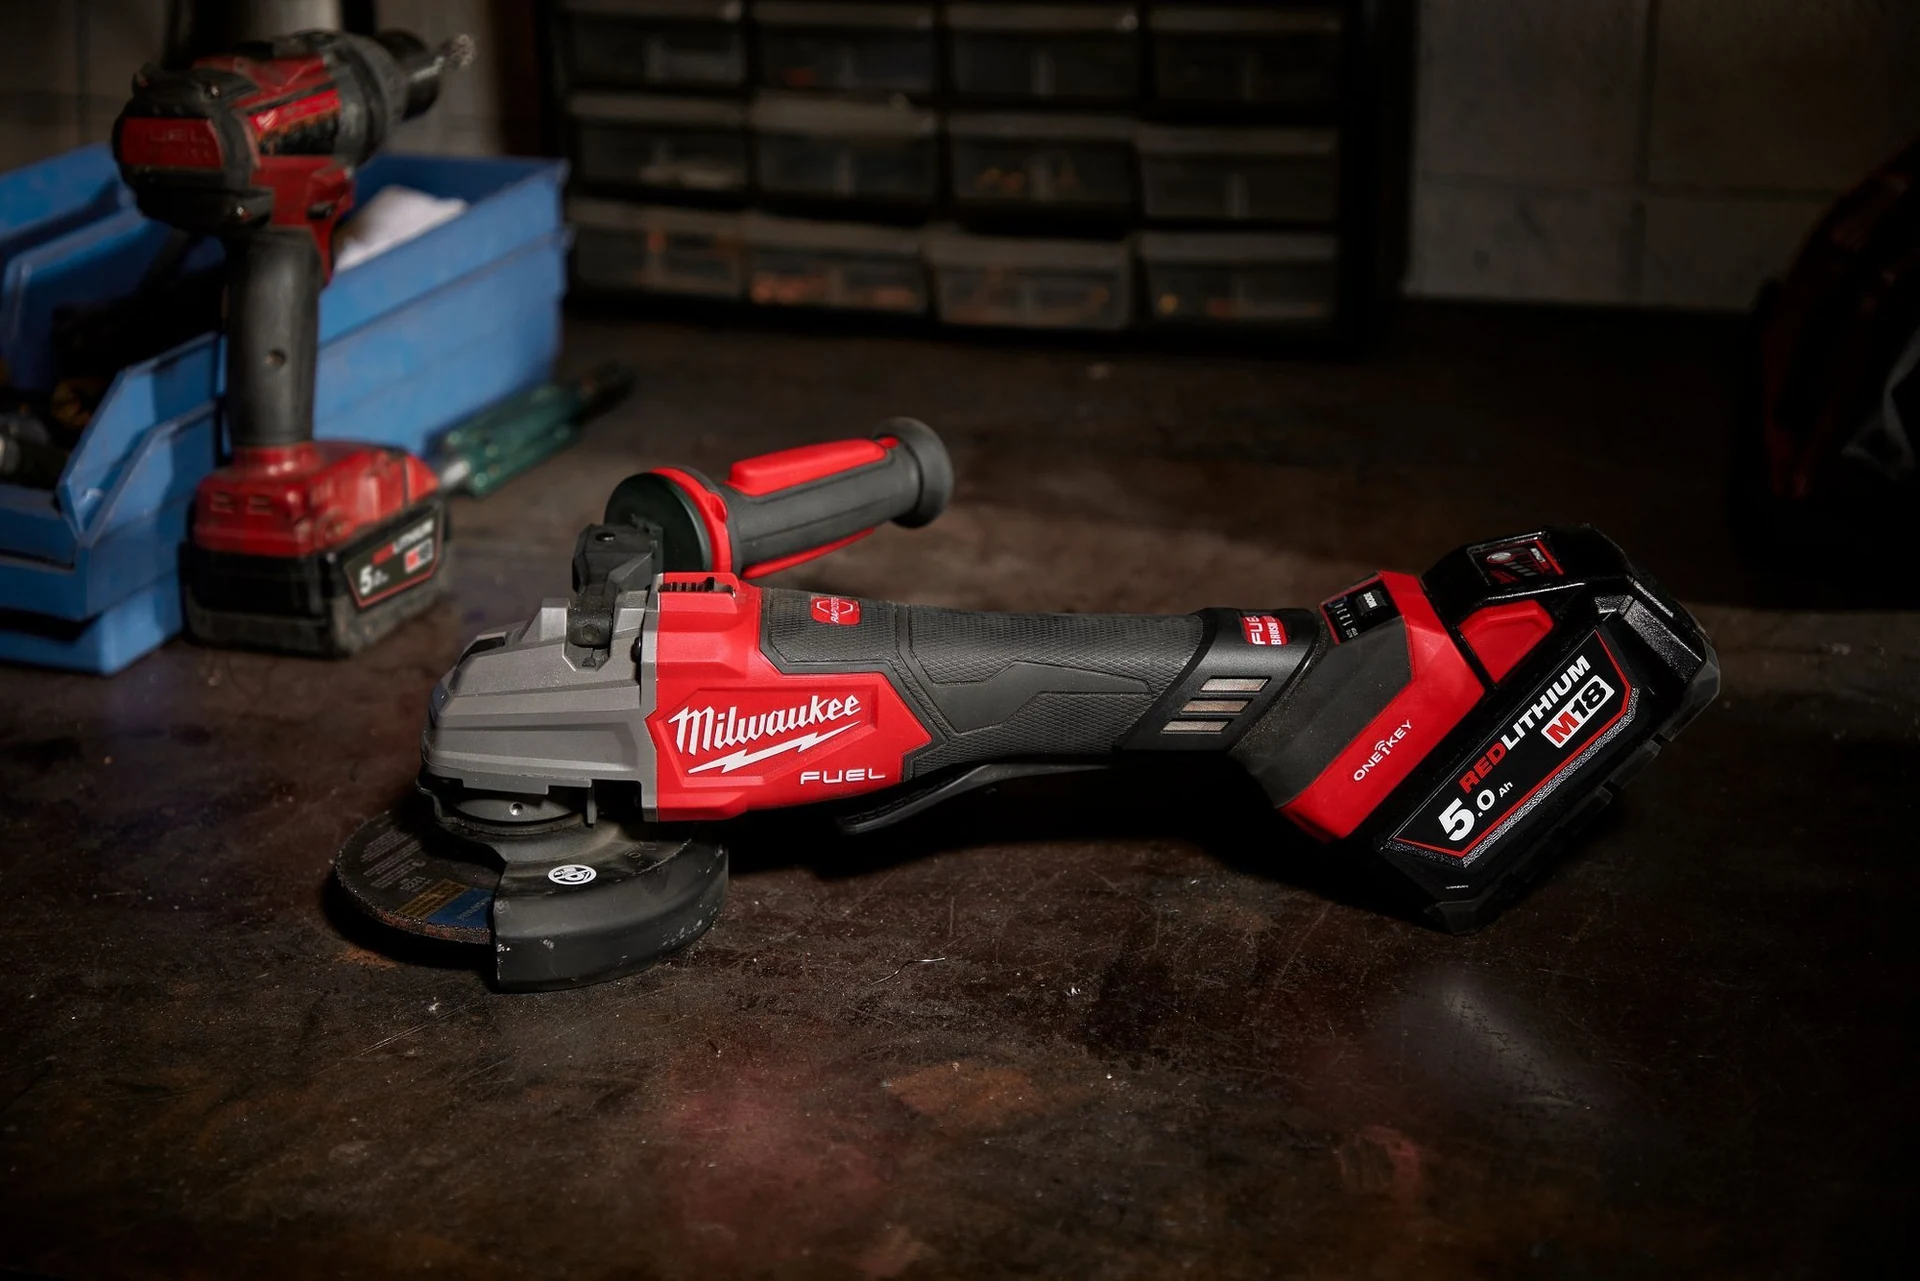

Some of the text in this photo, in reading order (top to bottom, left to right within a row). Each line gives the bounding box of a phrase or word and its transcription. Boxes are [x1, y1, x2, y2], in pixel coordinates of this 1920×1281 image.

[668, 695, 861, 756] Milwaukee
[1458, 655, 1591, 794] REDLITHIUM
[1546, 680, 1608, 744] M18
[800, 768, 886, 785] FUEL
[1438, 780, 1514, 842] 5.0 Ah
